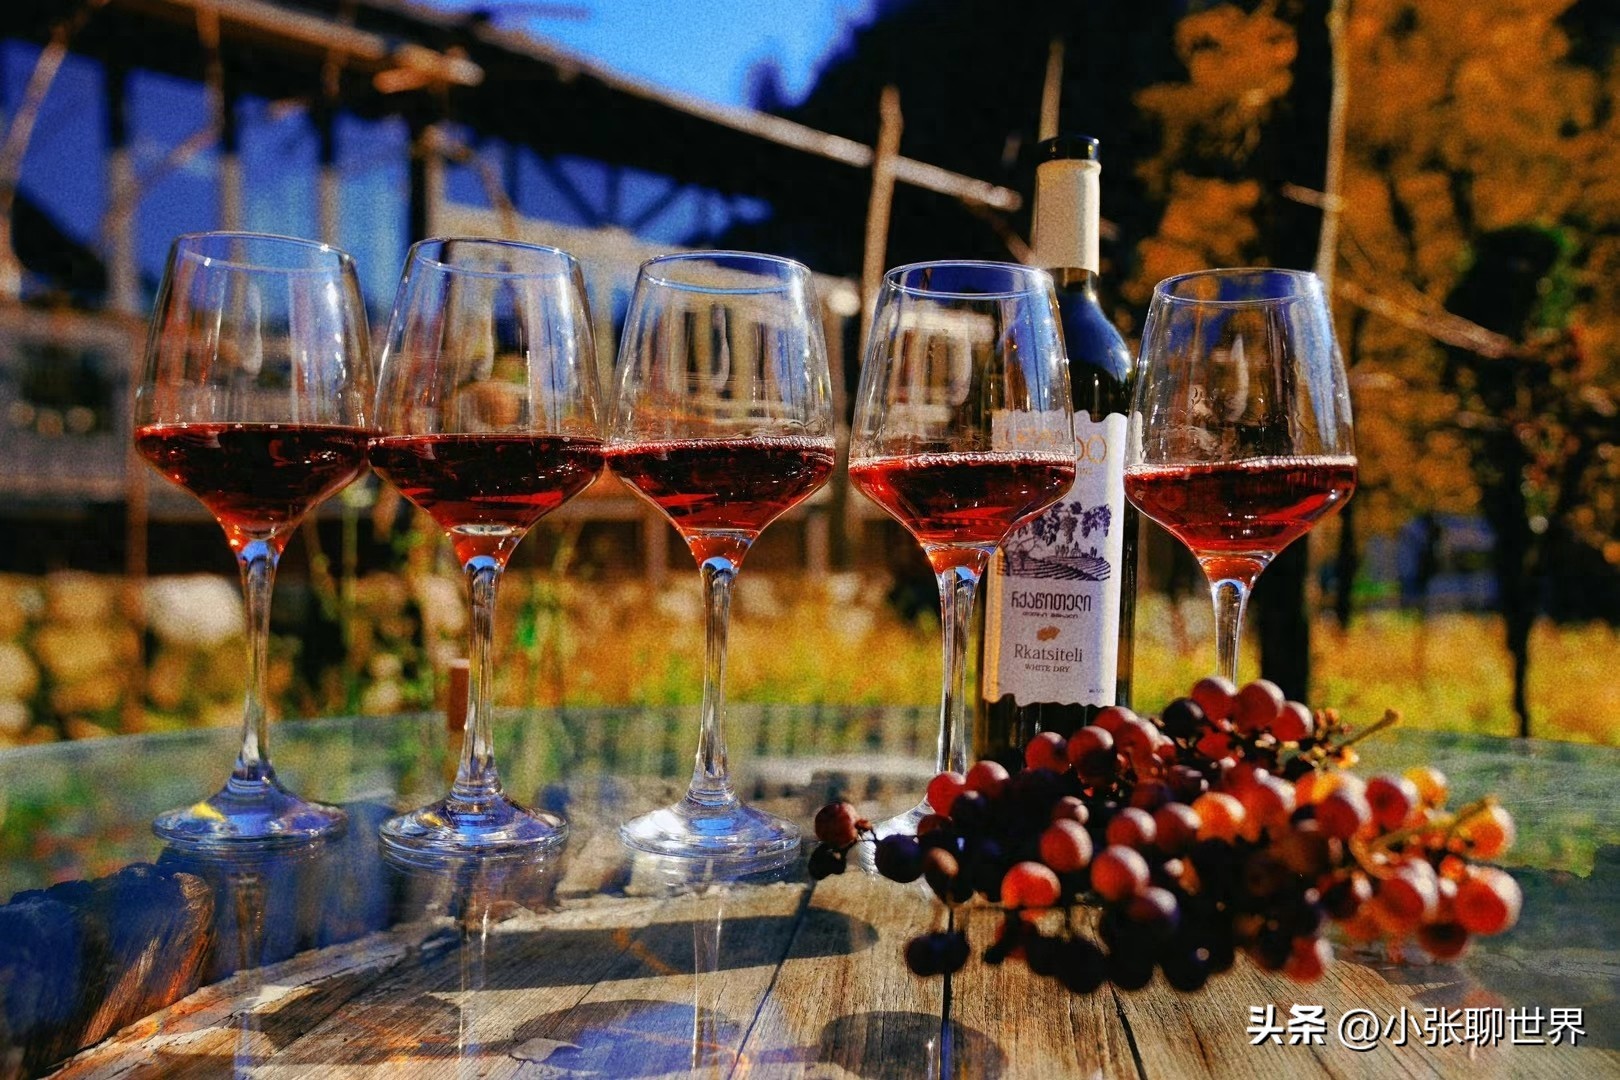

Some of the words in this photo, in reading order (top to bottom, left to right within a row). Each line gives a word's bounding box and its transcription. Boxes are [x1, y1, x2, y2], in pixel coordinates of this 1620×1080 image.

[1013, 643, 1083, 662] Rkatsiteli
[1024, 663, 1051, 672] WHITE
[1052, 665, 1071, 673] DRY
